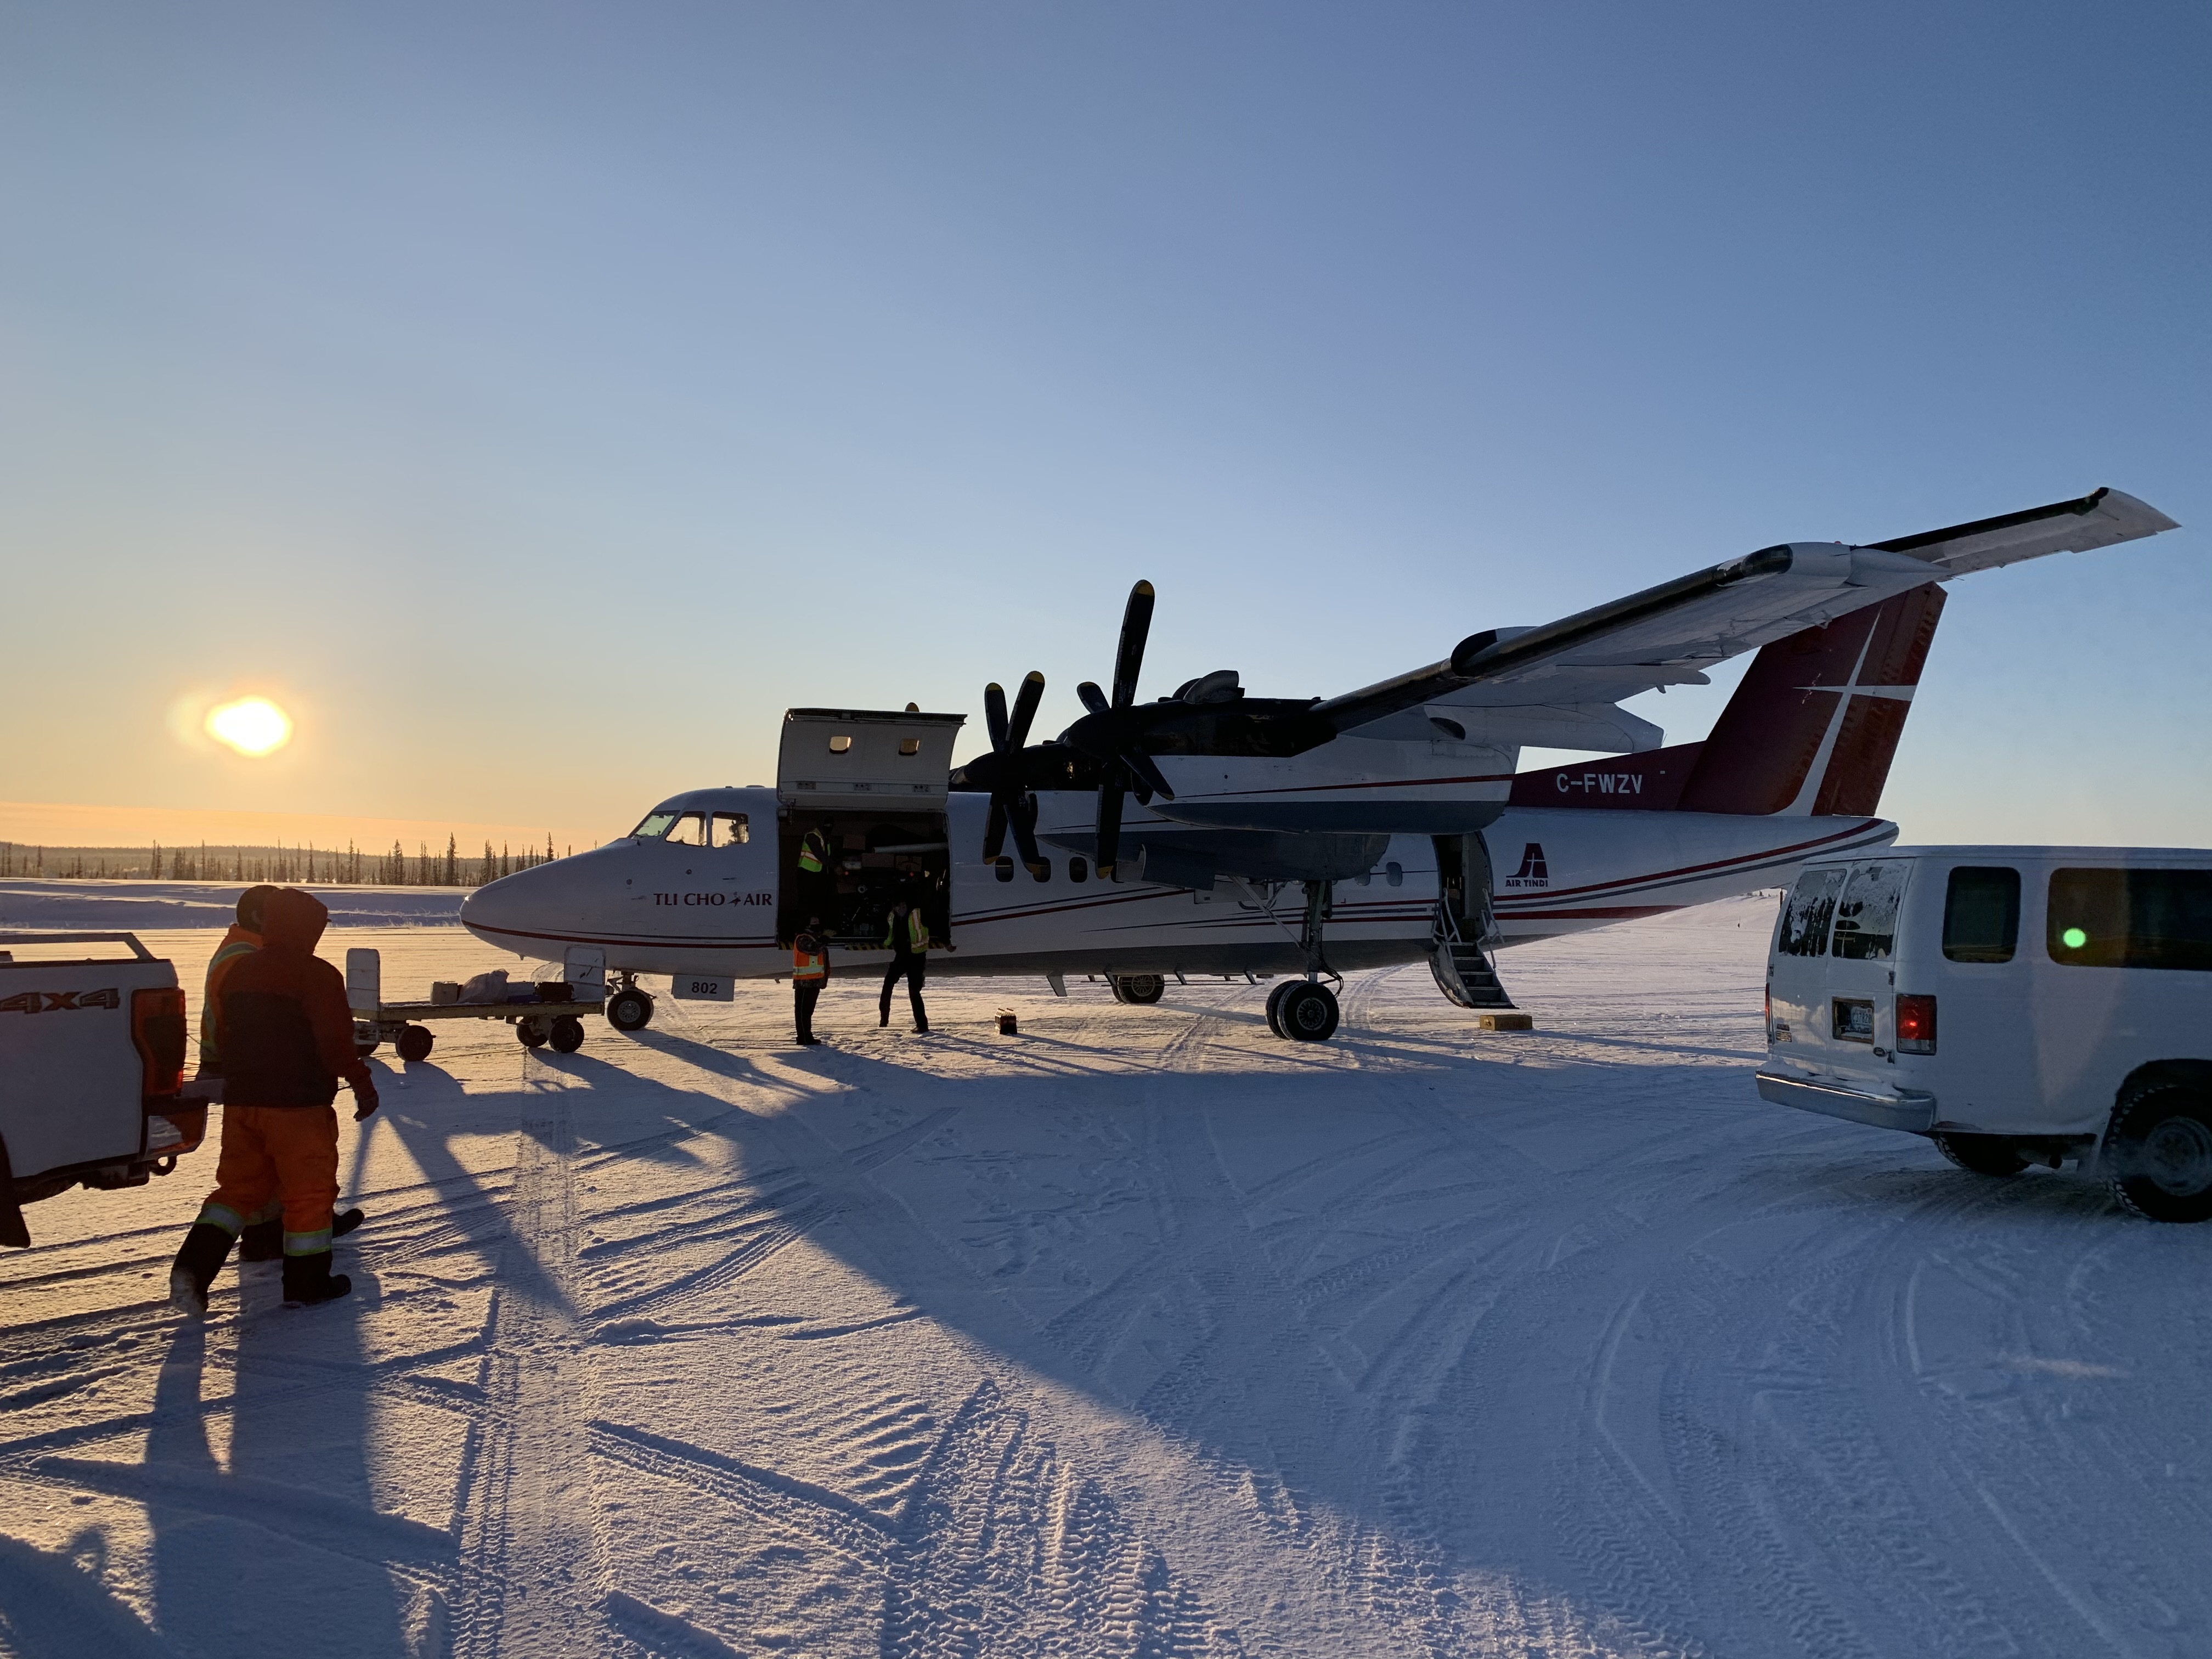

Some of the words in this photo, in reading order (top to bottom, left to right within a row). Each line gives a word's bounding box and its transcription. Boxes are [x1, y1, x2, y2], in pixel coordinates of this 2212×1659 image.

[1556, 773, 1643, 794] C-FWZV
[653, 893, 678, 906] TLI
[684, 893, 725, 906] CHO
[743, 893, 773, 906] AIR
[691, 981, 718, 994] 802
